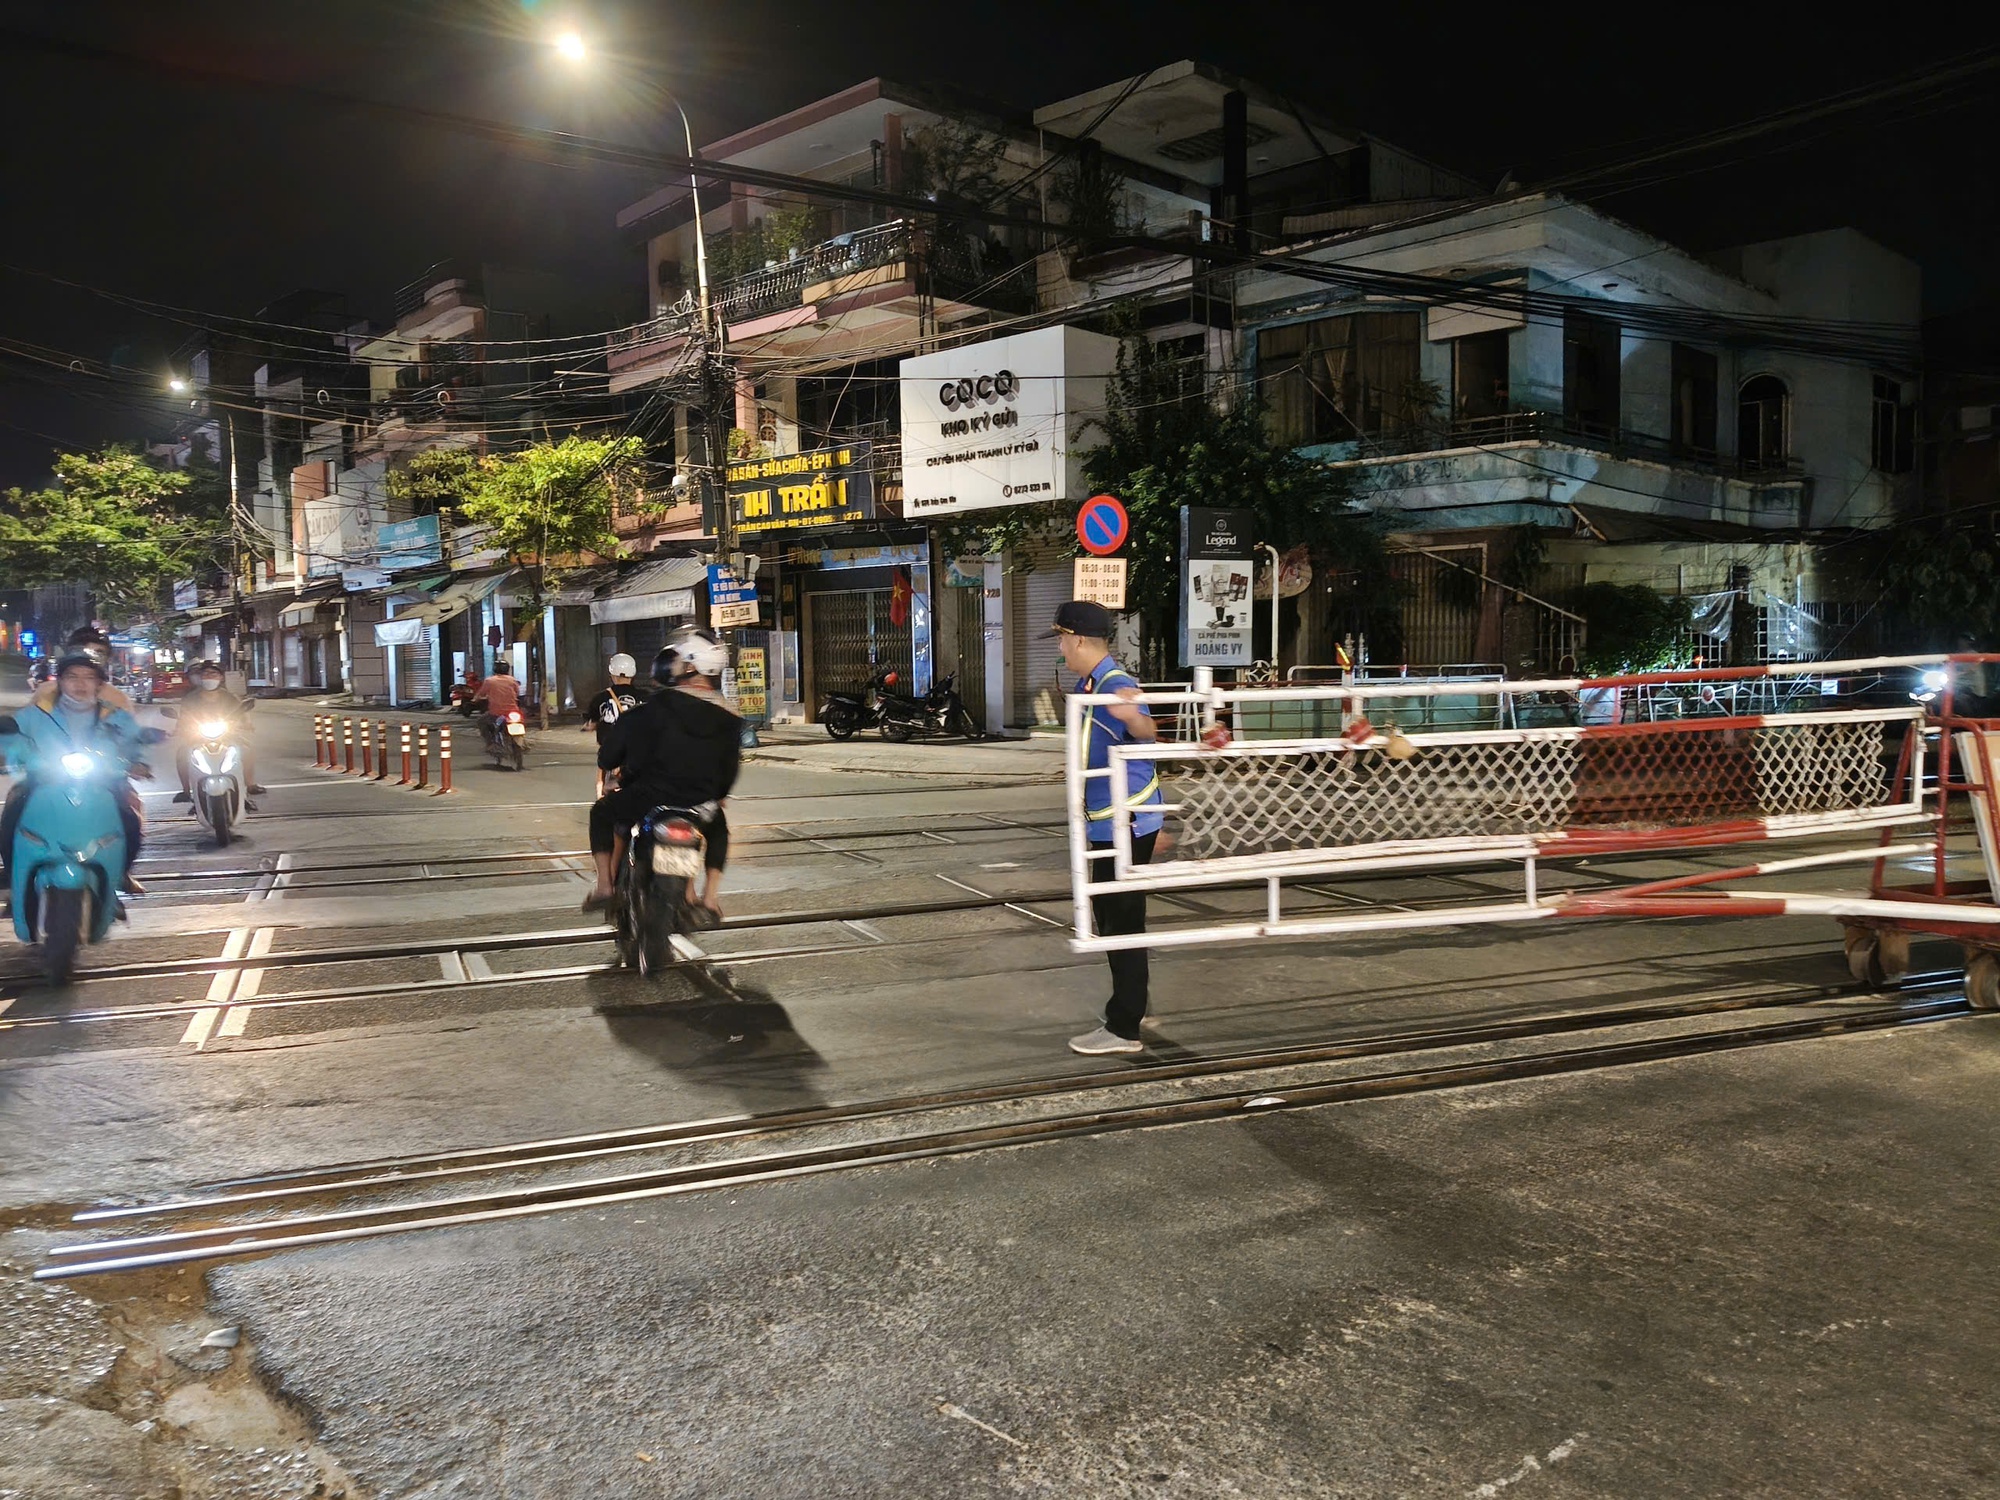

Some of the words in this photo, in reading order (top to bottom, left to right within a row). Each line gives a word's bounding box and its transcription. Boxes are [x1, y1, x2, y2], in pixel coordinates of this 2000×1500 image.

[940, 369, 1018, 408] COCO
[941, 419, 969, 438] KHO
[1205, 534, 1237, 548] Legend
[1230, 643, 1243, 655] VY
